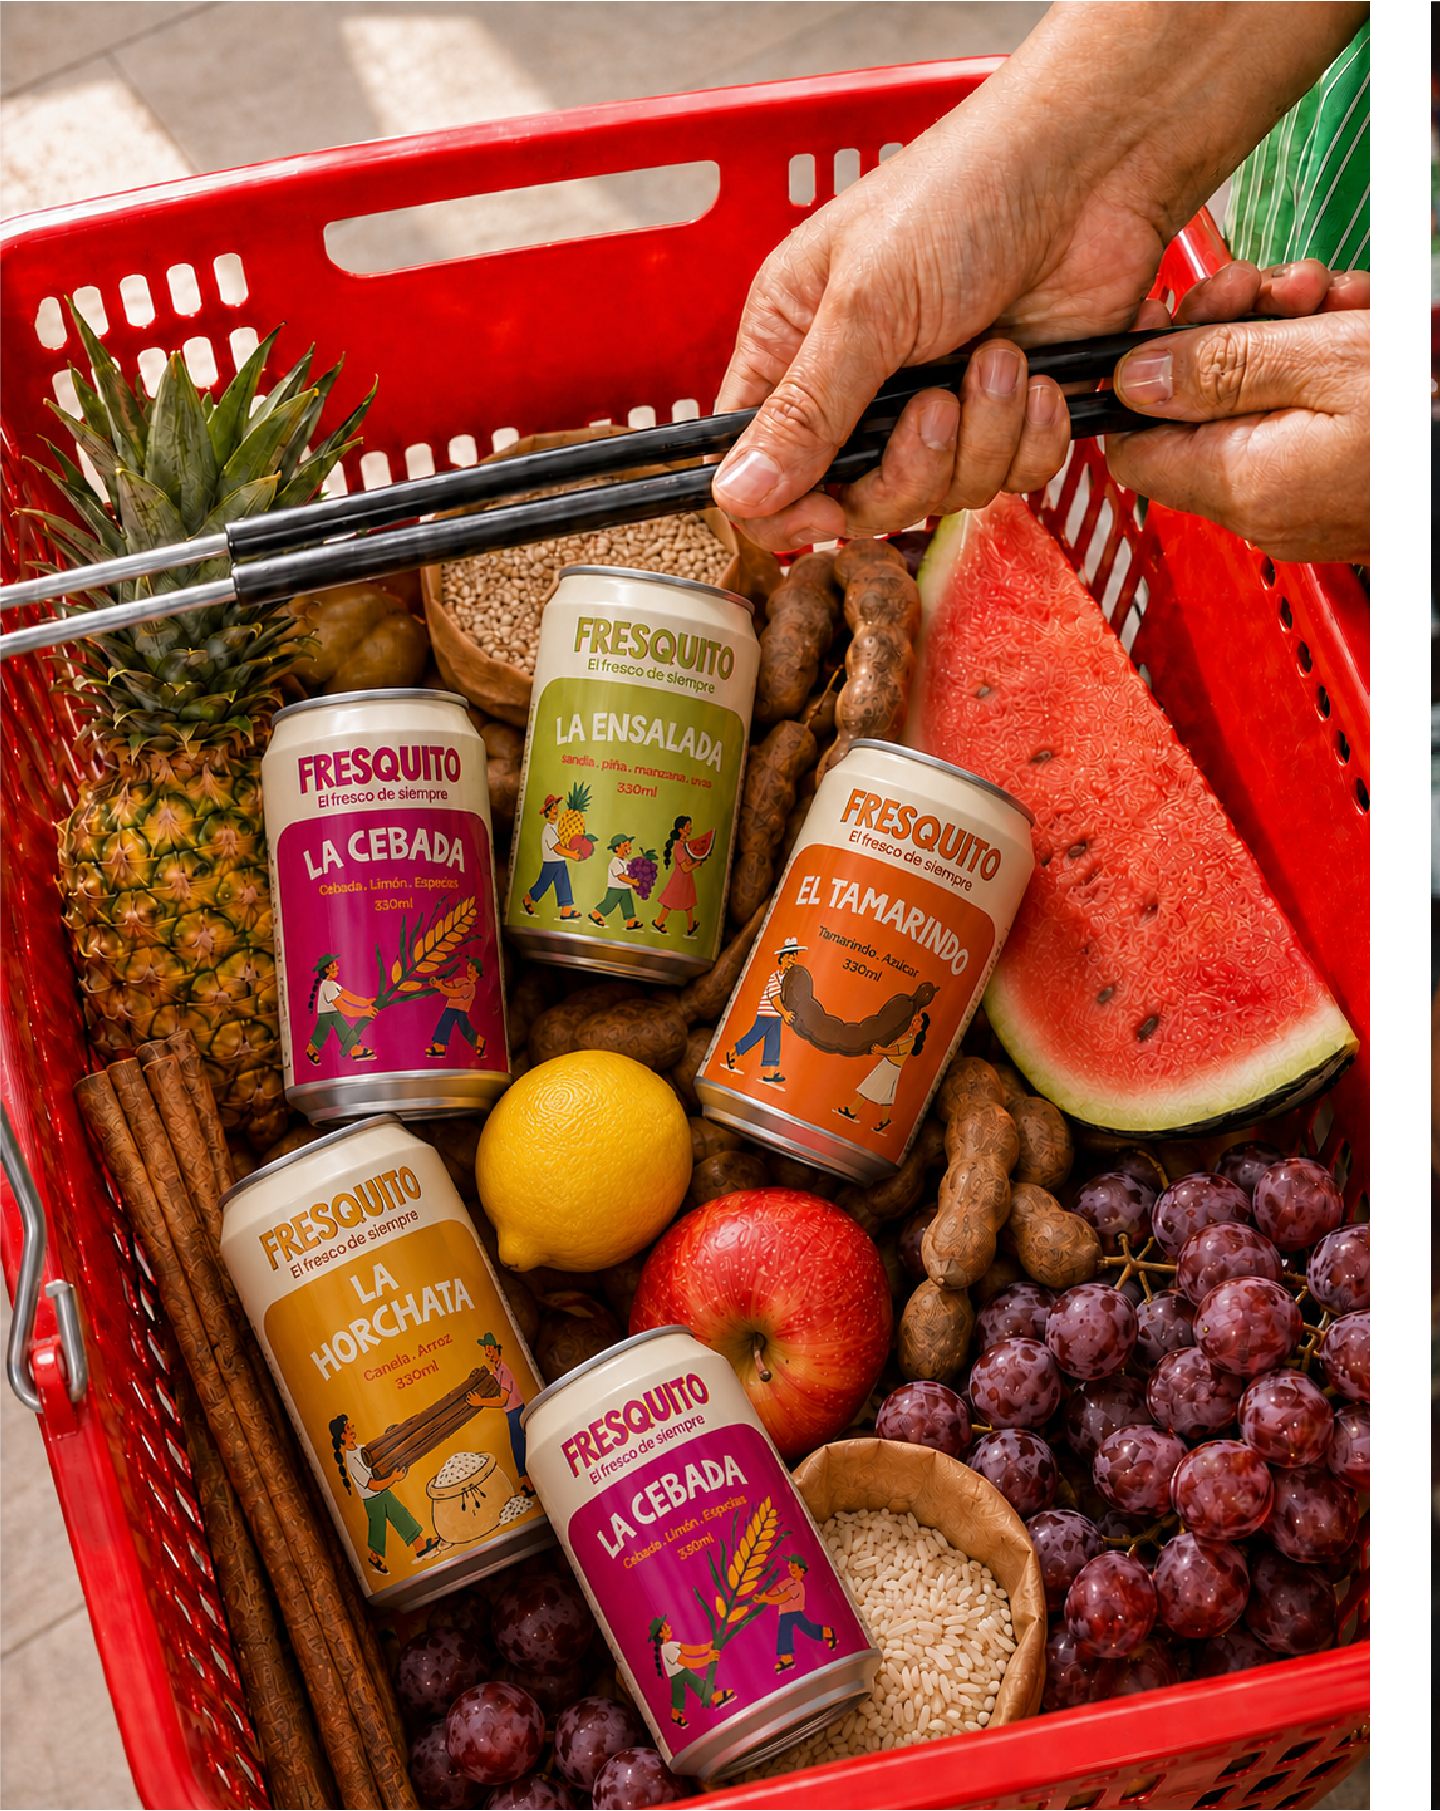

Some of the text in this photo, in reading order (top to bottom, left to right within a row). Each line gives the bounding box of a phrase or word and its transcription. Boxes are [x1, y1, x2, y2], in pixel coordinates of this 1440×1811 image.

[574, 617, 734, 681] FRESQUITO
[588, 659, 715, 694] El fresco de siempre
[557, 713, 723, 772] LA ENSALADA
[298, 745, 461, 794] FRESQUITO
[617, 782, 658, 797] 330ml
[318, 786, 447, 808] El fresco de siempre
[303, 827, 465, 880] LA CEBADA
[840, 788, 1001, 881] FRESQUITO
[849, 830, 972, 891] El fresco de siempre
[371, 877, 407, 890] Limón
[375, 897, 413, 911] 330ml
[796, 876, 968, 975] EL TAMARINDO
[819, 926, 877, 958] Tamarindo
[843, 959, 882, 982] 330ml
[259, 1166, 421, 1270] FRESQUITO
[290, 1210, 418, 1278] El fresco de siempre
[350, 1263, 399, 1304] LA
[310, 1278, 475, 1381] HORCHATA
[364, 1334, 453, 1382] Canela Arroz
[395, 1361, 439, 1390] 330ml
[562, 1373, 709, 1478] FRESQUITO
[589, 1415, 705, 1485] El fresco de siempre
[597, 1456, 749, 1558] LA CEBADA
